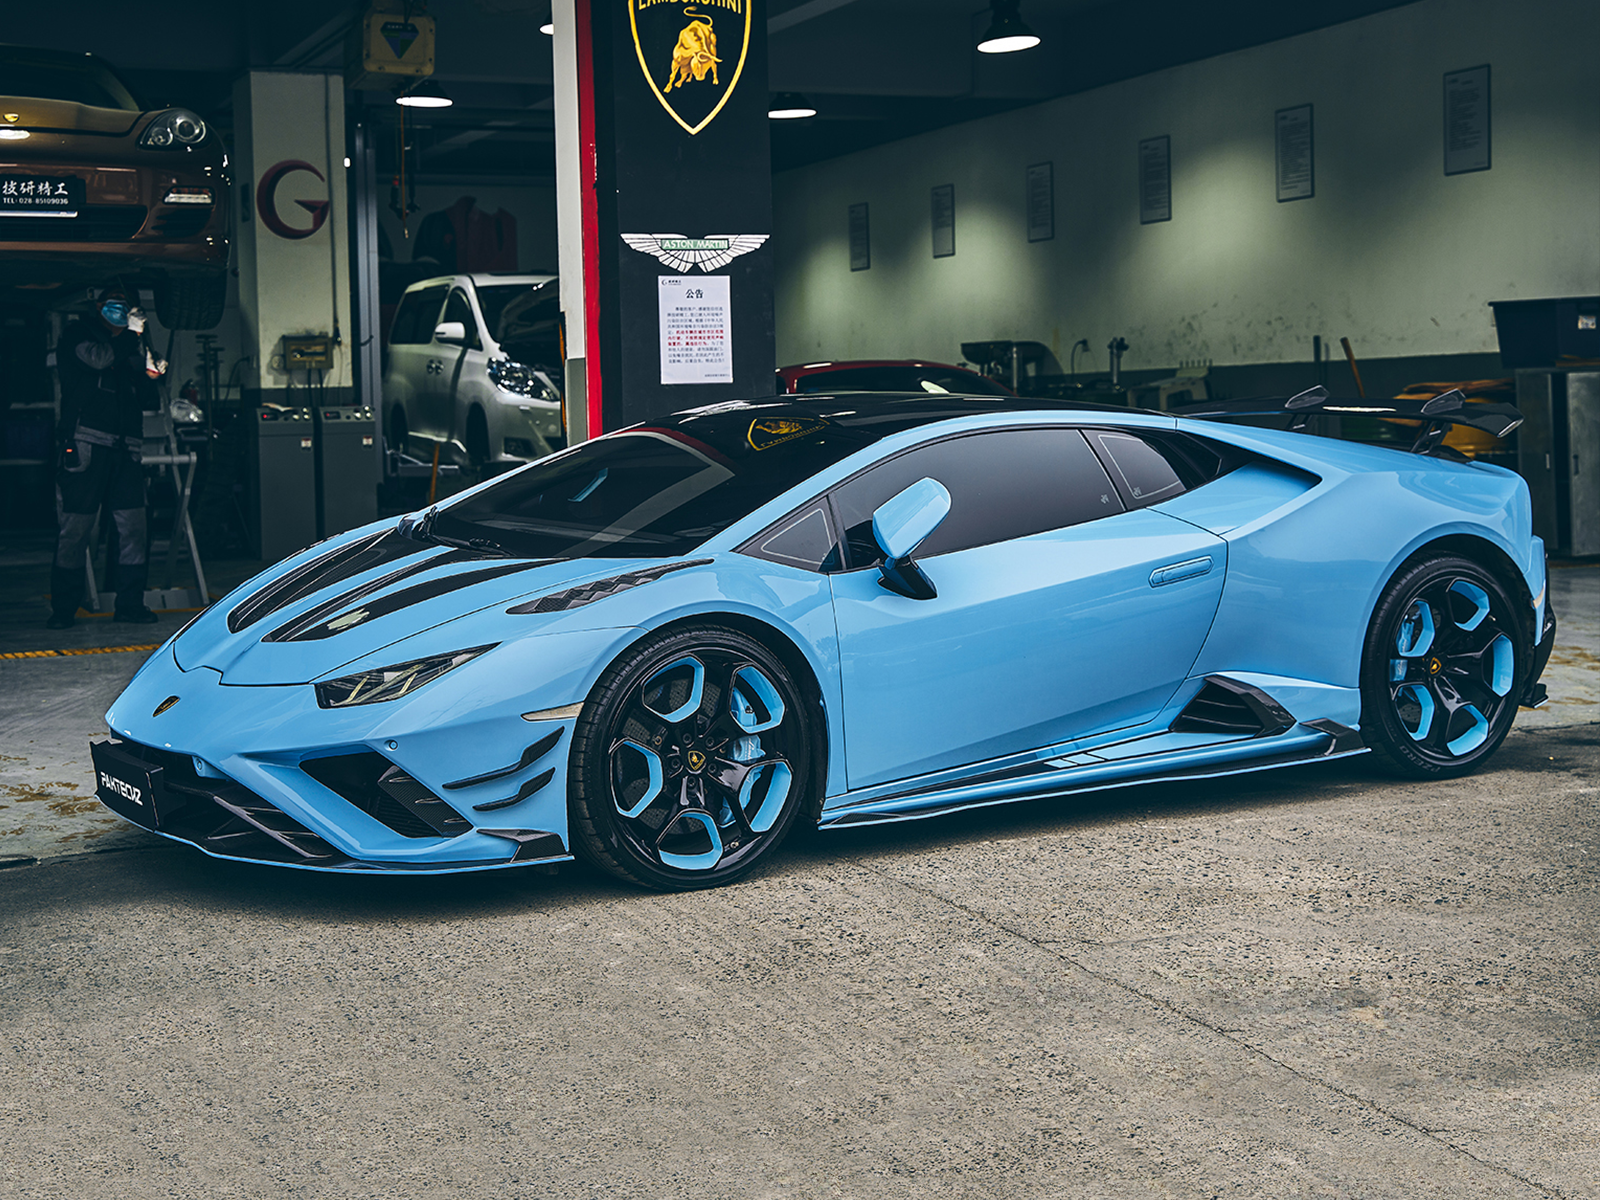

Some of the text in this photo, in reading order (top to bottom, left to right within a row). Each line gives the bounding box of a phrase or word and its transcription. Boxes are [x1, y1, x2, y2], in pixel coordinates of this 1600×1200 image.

[256, 159, 330, 240] G
[664, 240, 728, 249] ASTON MARTIN
[685, 288, 704, 299] 公告
